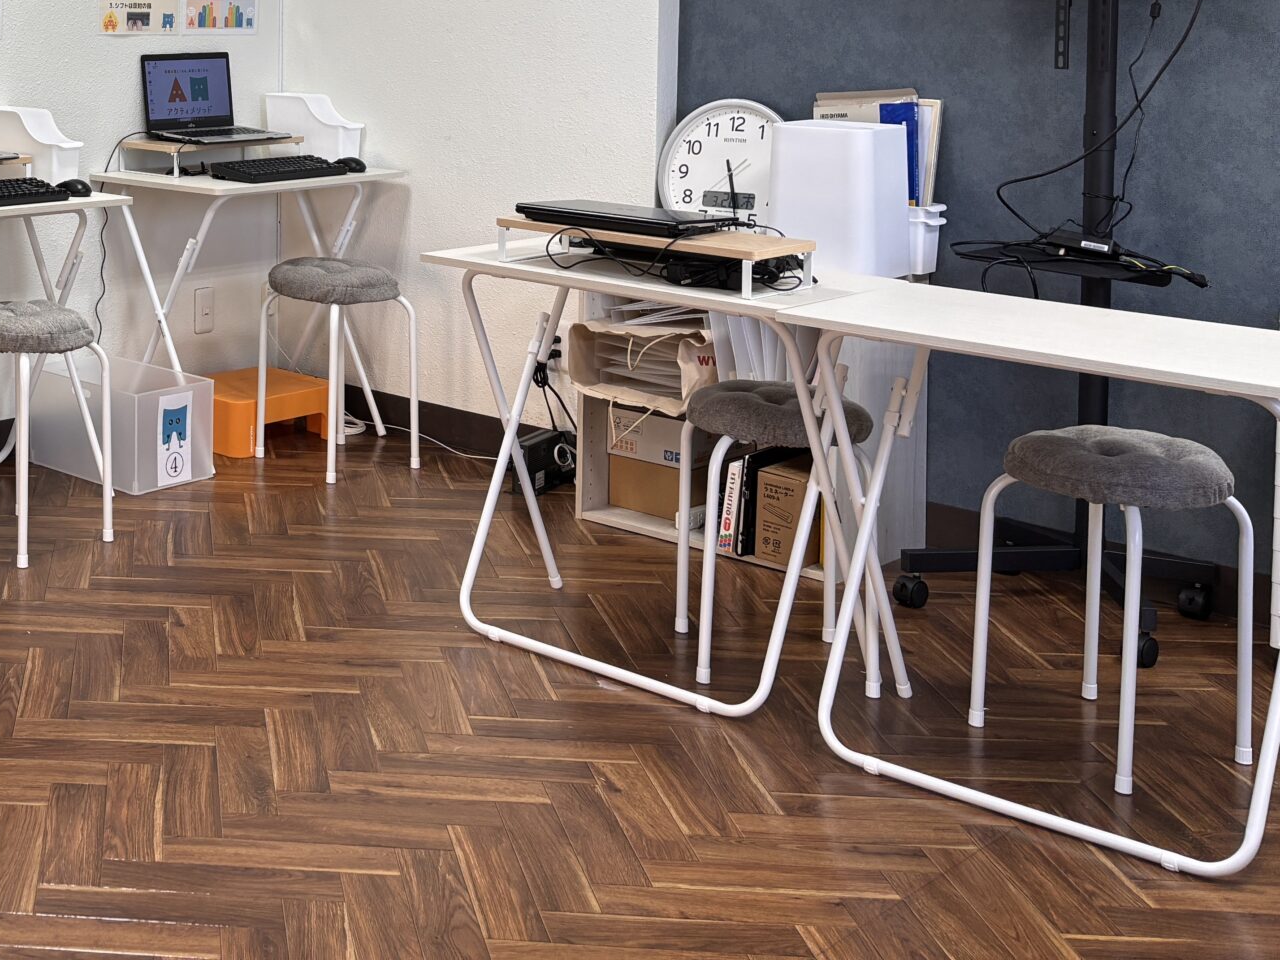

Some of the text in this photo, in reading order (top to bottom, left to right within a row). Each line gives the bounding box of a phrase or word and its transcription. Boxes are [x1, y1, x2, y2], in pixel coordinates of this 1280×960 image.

[705, 122, 720, 137] 11
[729, 116, 746, 132] 12
[758, 124, 765, 140] 1
[685, 140, 703, 155] 10
[678, 164, 689, 179] 9
[682, 189, 693, 204] 8
